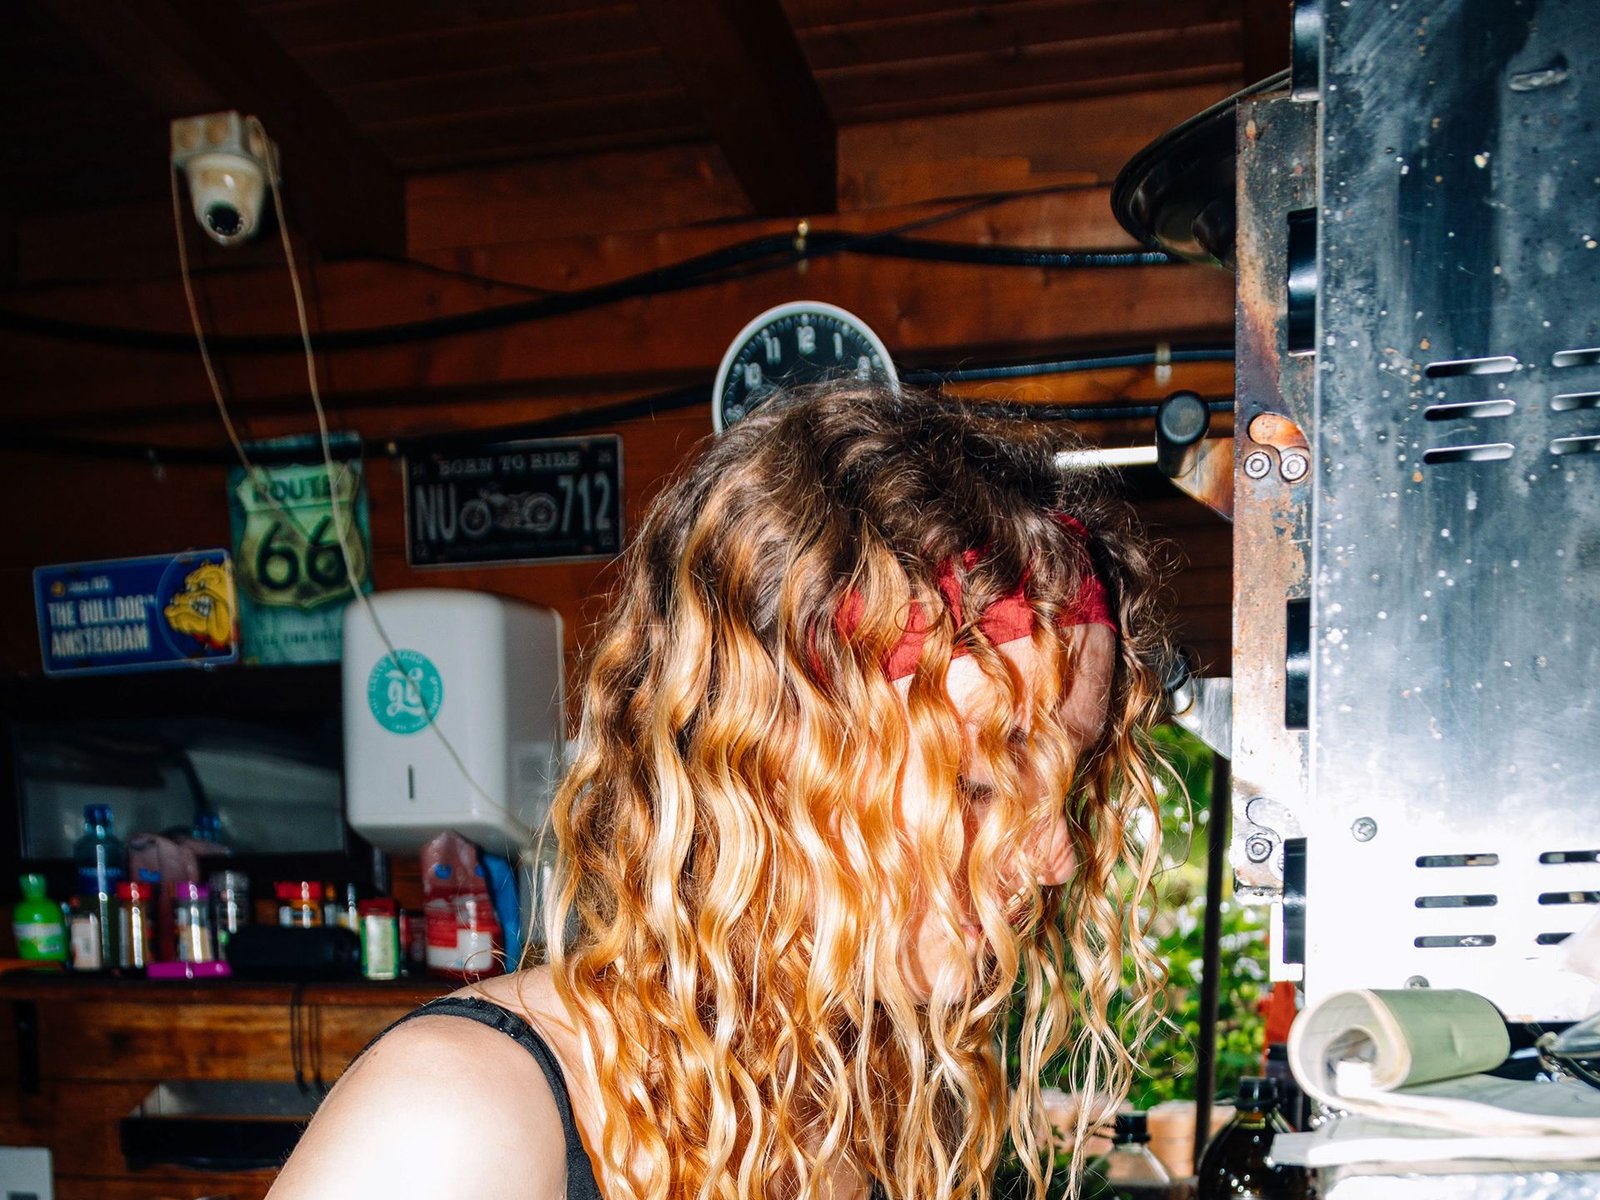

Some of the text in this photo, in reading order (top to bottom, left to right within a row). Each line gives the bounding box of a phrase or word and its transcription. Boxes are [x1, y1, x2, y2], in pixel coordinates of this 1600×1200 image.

[498, 454, 527, 472] TO
[415, 471, 612, 542] NU 712
[256, 514, 349, 591] 66
[48, 601, 77, 628] THE
[51, 623, 149, 657] AMSTERDAM
